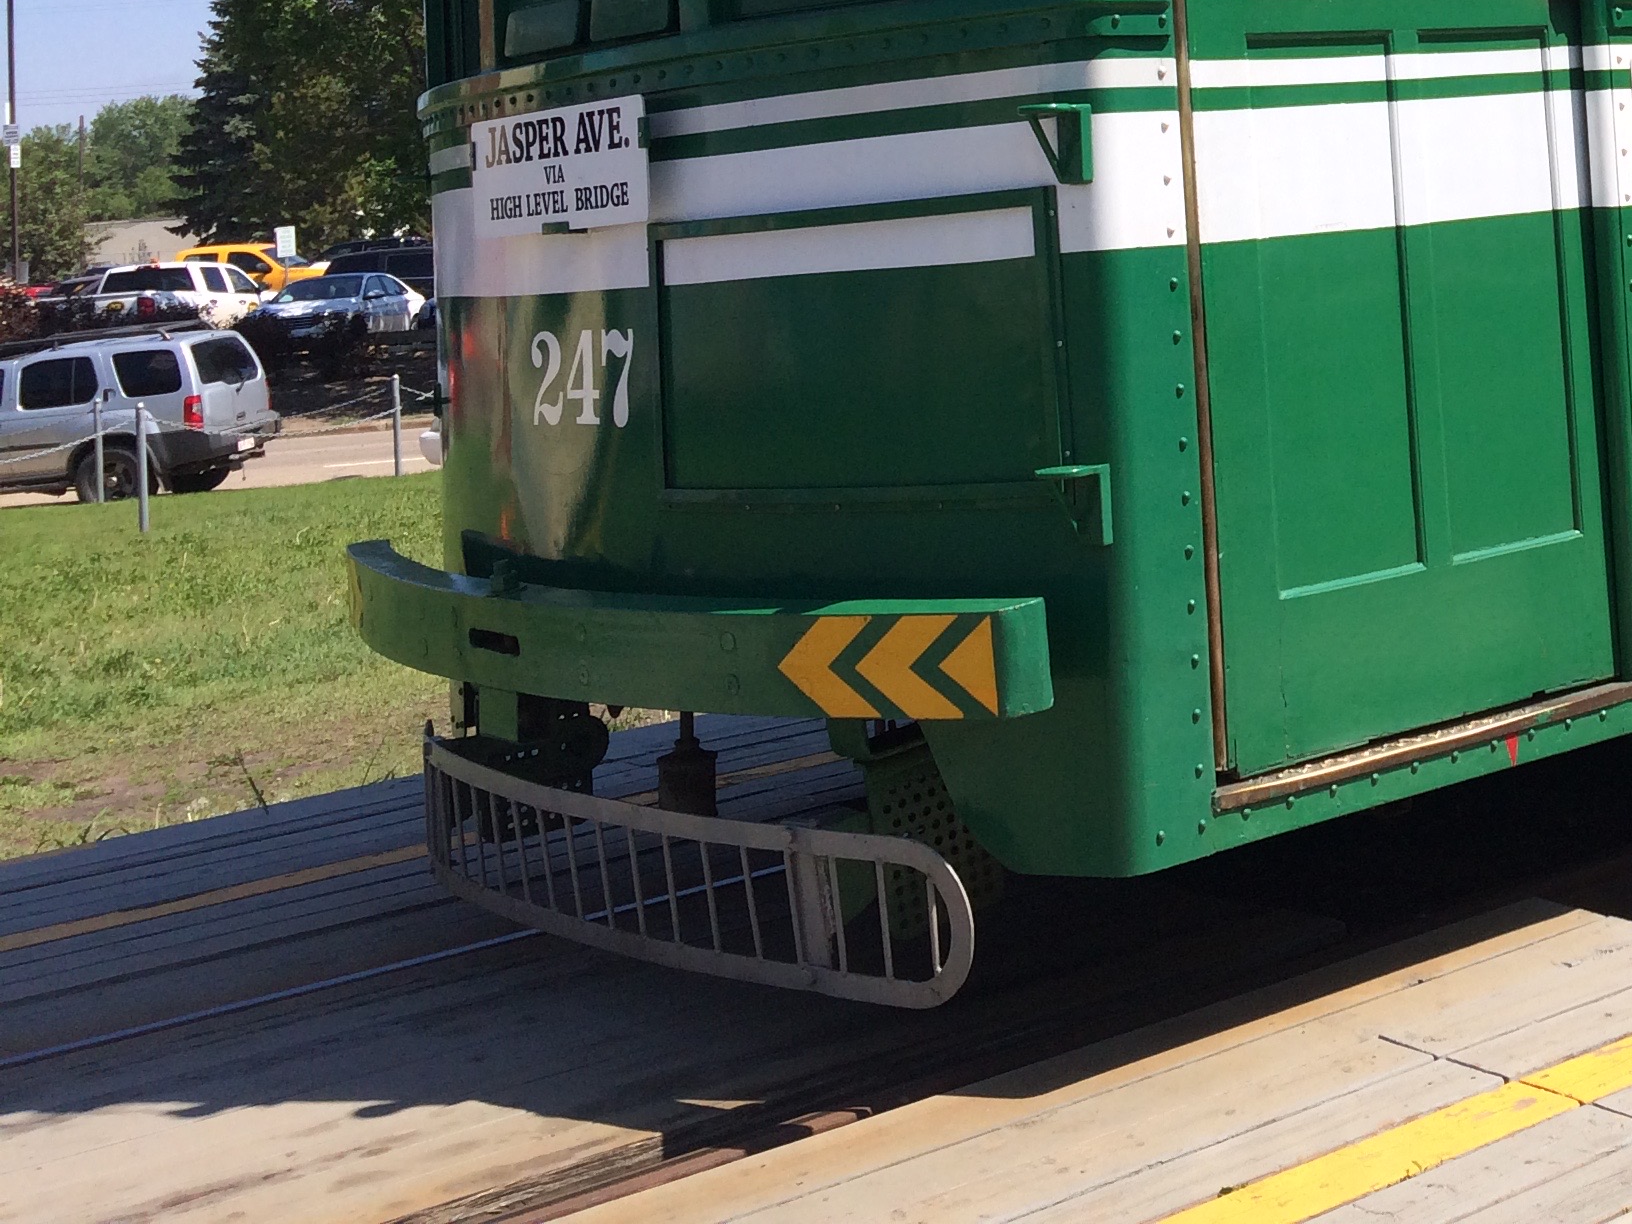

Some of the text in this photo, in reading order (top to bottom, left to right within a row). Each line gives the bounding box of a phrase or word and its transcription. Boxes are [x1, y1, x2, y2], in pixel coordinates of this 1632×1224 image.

[485, 106, 630, 168] JASPER AVE.
[543, 163, 566, 185] VIA
[489, 181, 630, 221] HIGH LEVEL BRIDGE
[531, 328, 634, 428] 247
